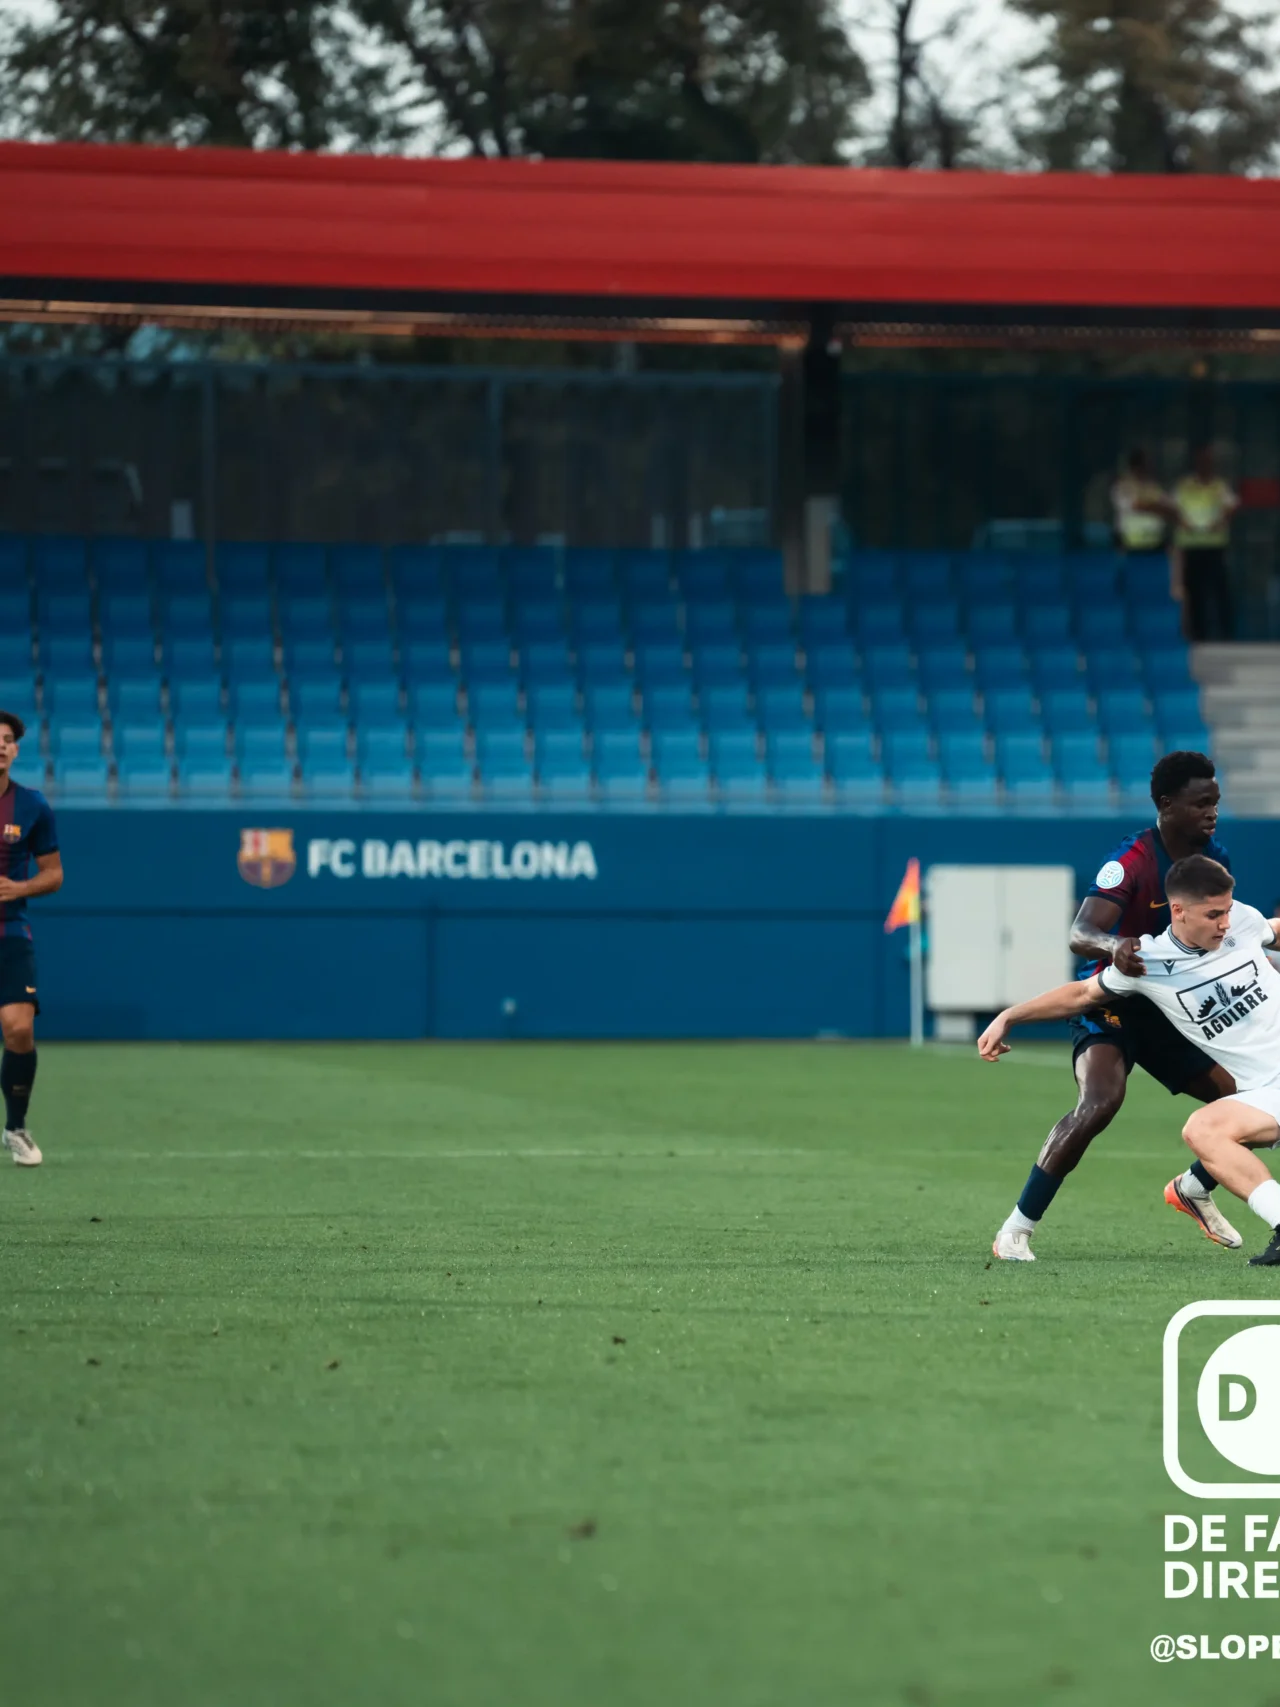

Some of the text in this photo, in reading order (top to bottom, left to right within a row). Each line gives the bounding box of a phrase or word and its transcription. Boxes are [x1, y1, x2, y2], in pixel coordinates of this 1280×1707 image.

[307, 838, 599, 880] FC BARCELONA
[1201, 986, 1268, 1040] AGUIRRE
